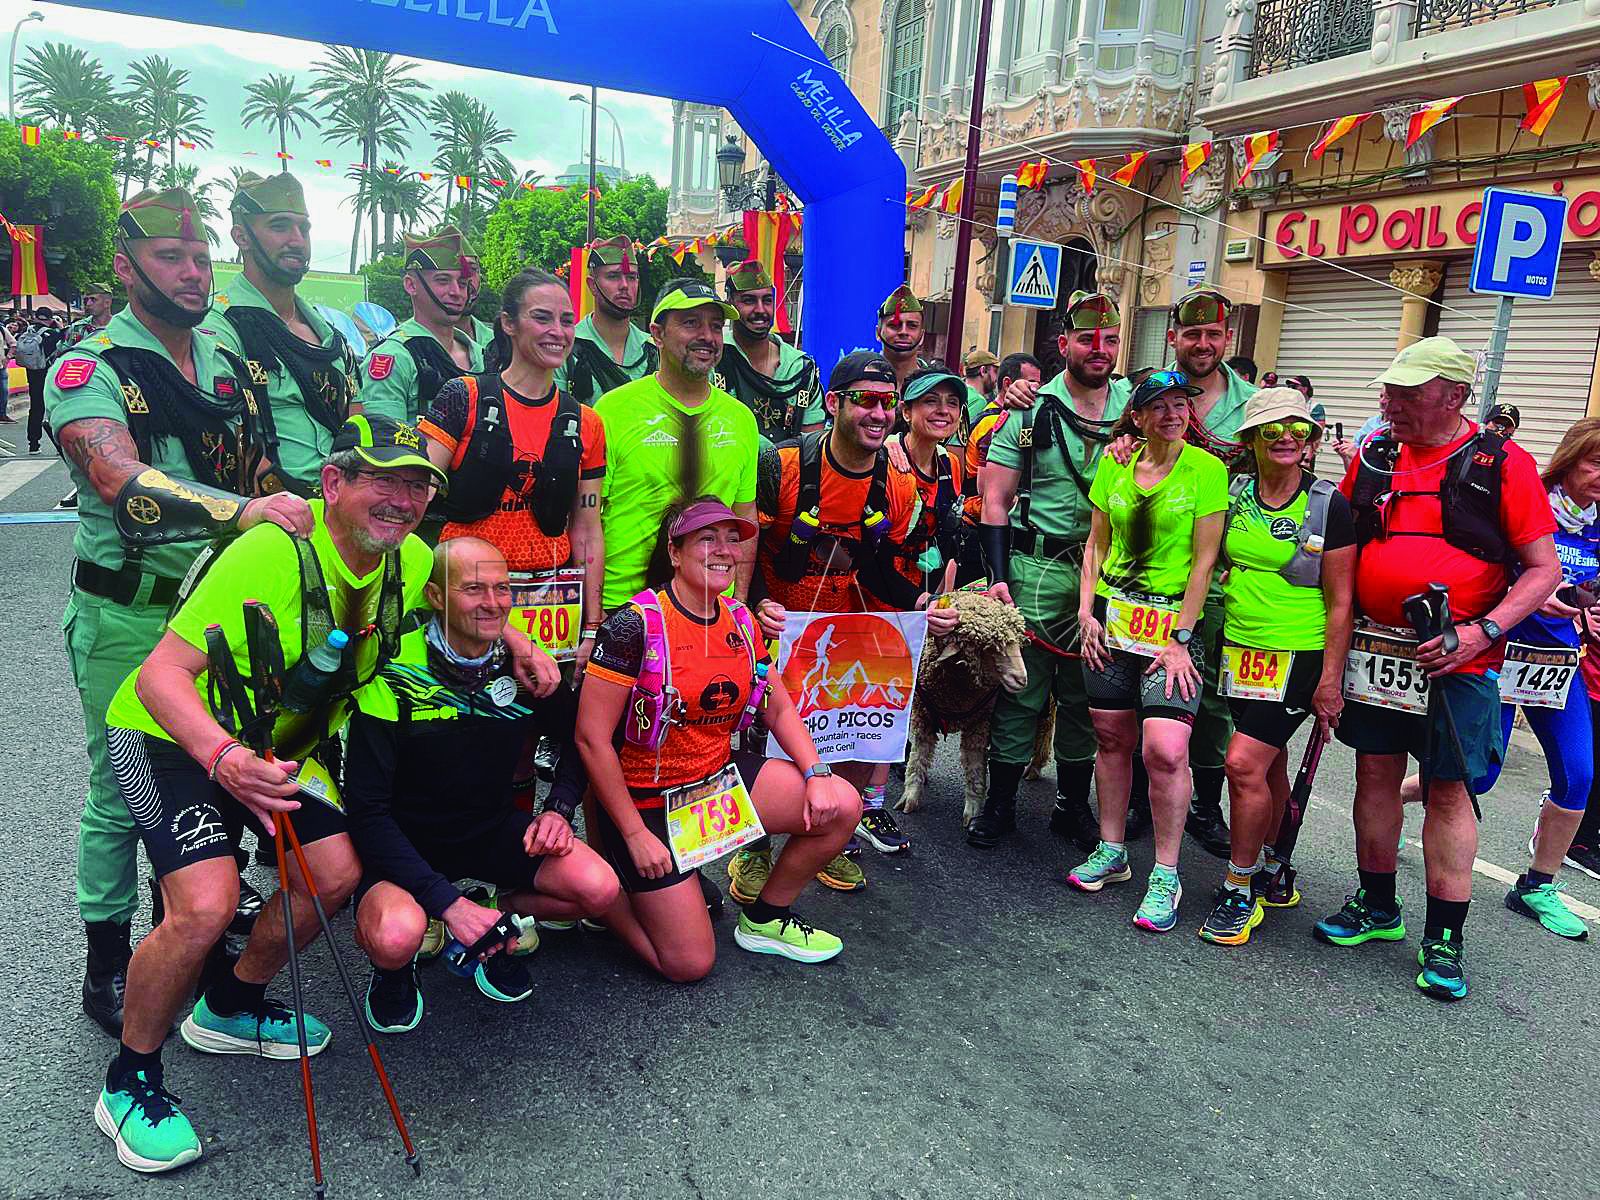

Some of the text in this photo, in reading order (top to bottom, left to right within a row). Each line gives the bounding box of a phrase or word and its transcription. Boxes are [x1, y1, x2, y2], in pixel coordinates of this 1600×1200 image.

[796, 68, 863, 147] MELILLA
[1491, 202, 1547, 282] P
[1525, 274, 1548, 286] MOTOS
[582, 494, 597, 508] 10
[522, 607, 569, 642] 780
[1129, 607, 1173, 641] 891
[1354, 637, 1367, 651] LA
[1239, 650, 1278, 681] 854
[1365, 656, 1428, 694] 1553
[1516, 665, 1571, 690] 1429
[1367, 685, 1407, 698] CORREDORES
[837, 711, 896, 728] PICOS
[835, 742, 856, 751] Genil
[856, 731, 882, 740] races
[689, 793, 741, 838] 759
